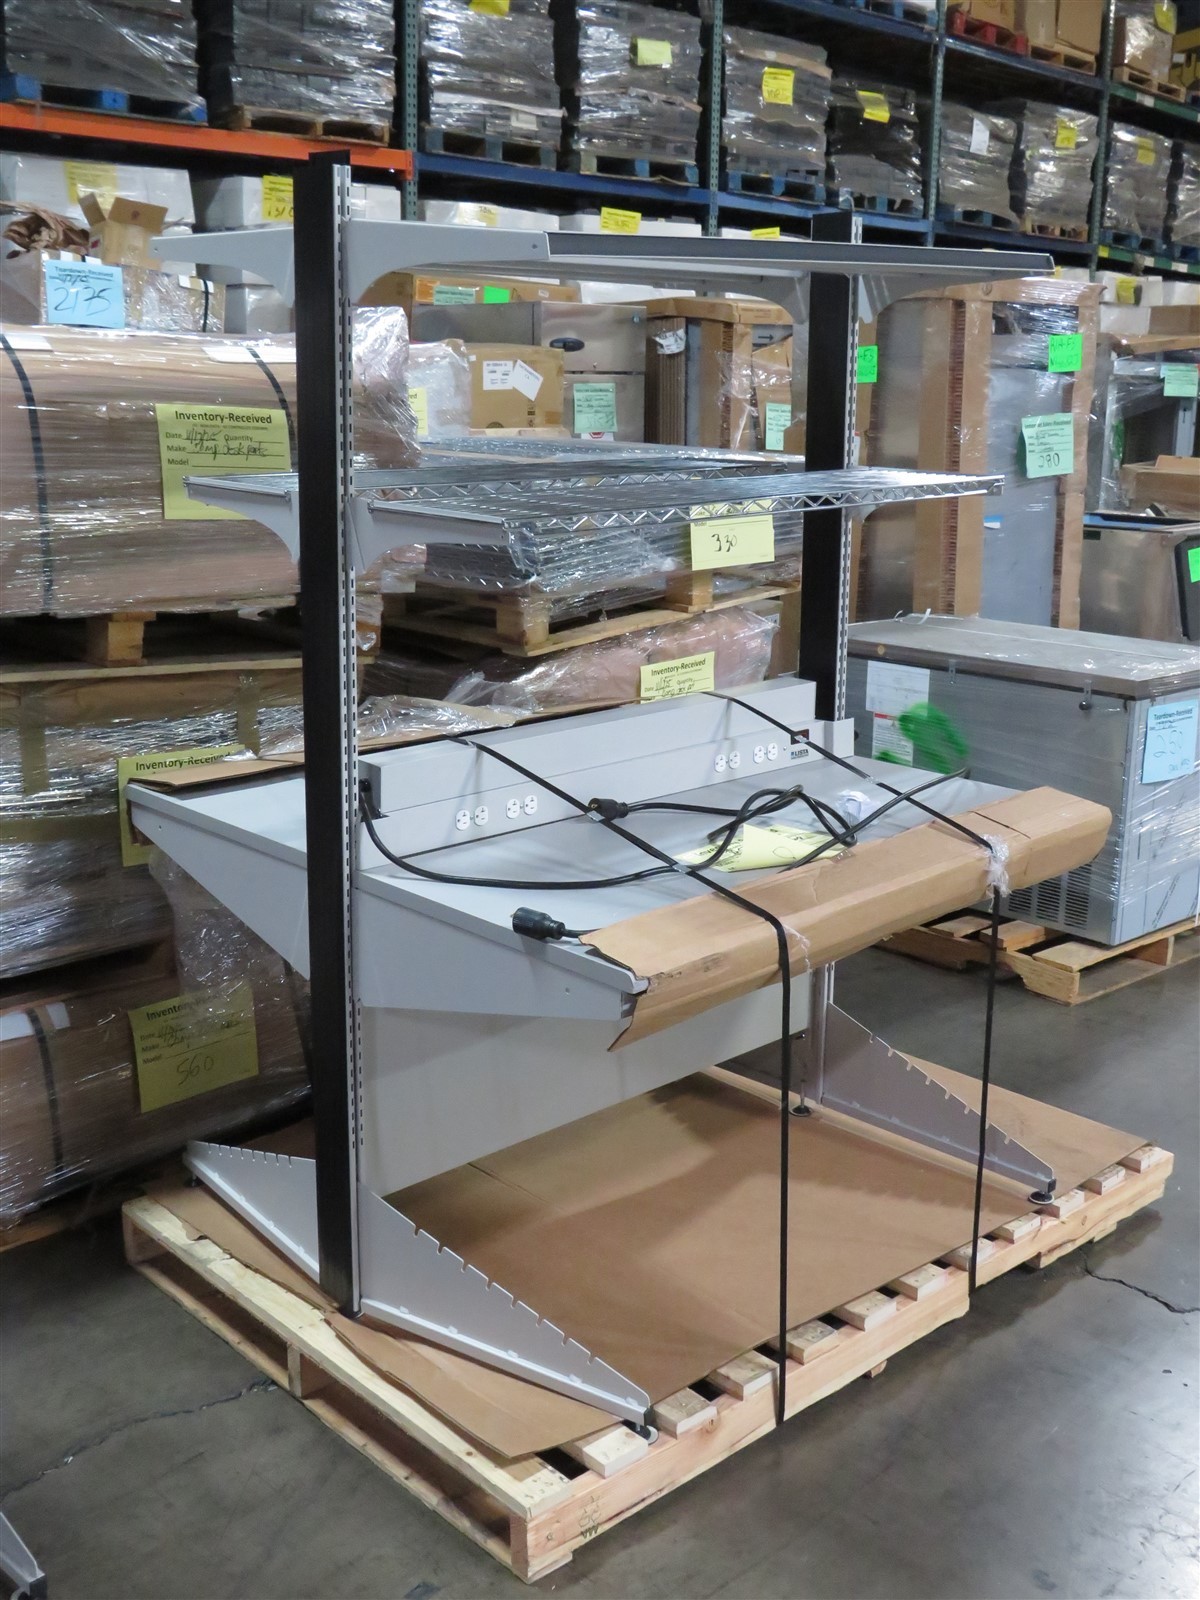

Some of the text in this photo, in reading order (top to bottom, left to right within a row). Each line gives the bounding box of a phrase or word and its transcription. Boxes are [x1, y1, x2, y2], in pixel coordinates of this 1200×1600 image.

[175, 411, 272, 424] Inventory-Received
[223, 434, 254, 442] Quantity
[168, 458, 189, 466] Model
[711, 533, 738, 553] 330
[651, 659, 706, 677] Inventory-Received
[177, 1052, 214, 1086] 560
